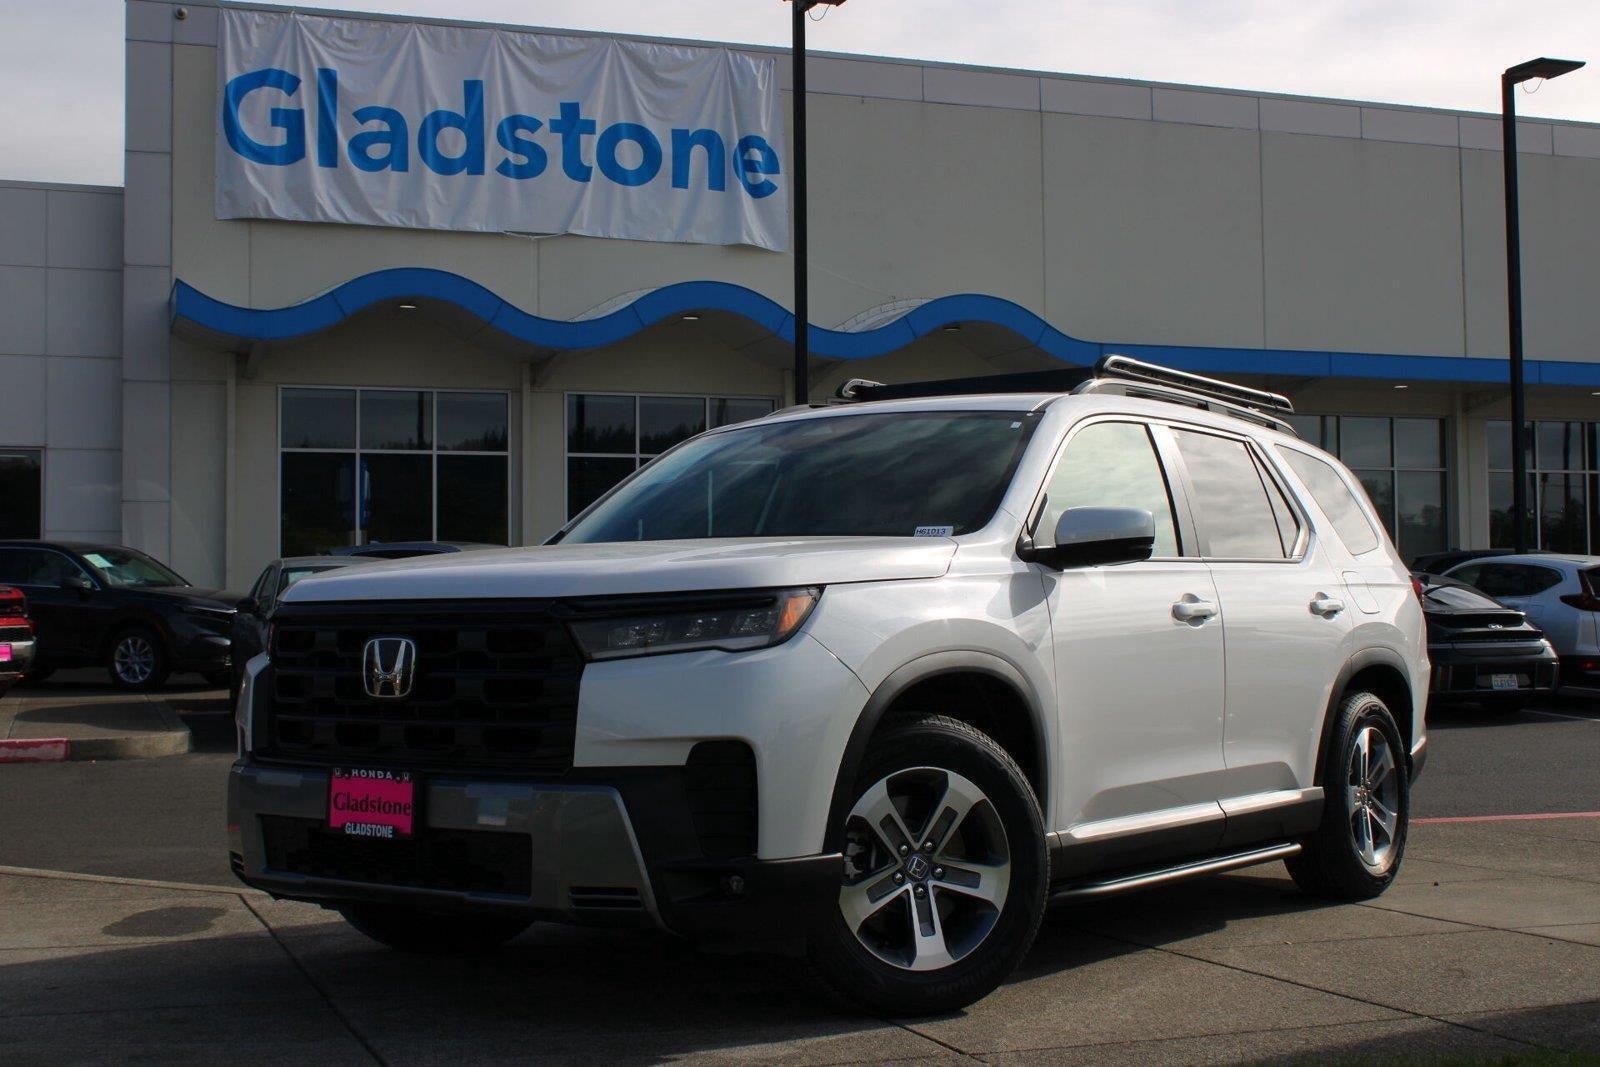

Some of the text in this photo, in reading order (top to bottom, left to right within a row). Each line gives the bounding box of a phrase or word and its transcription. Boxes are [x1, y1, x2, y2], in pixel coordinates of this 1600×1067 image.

[223, 68, 781, 199] Gladstone
[351, 768, 393, 779] HONDA
[333, 791, 412, 816] Gladstone
[345, 822, 394, 838] GLADSTONE
